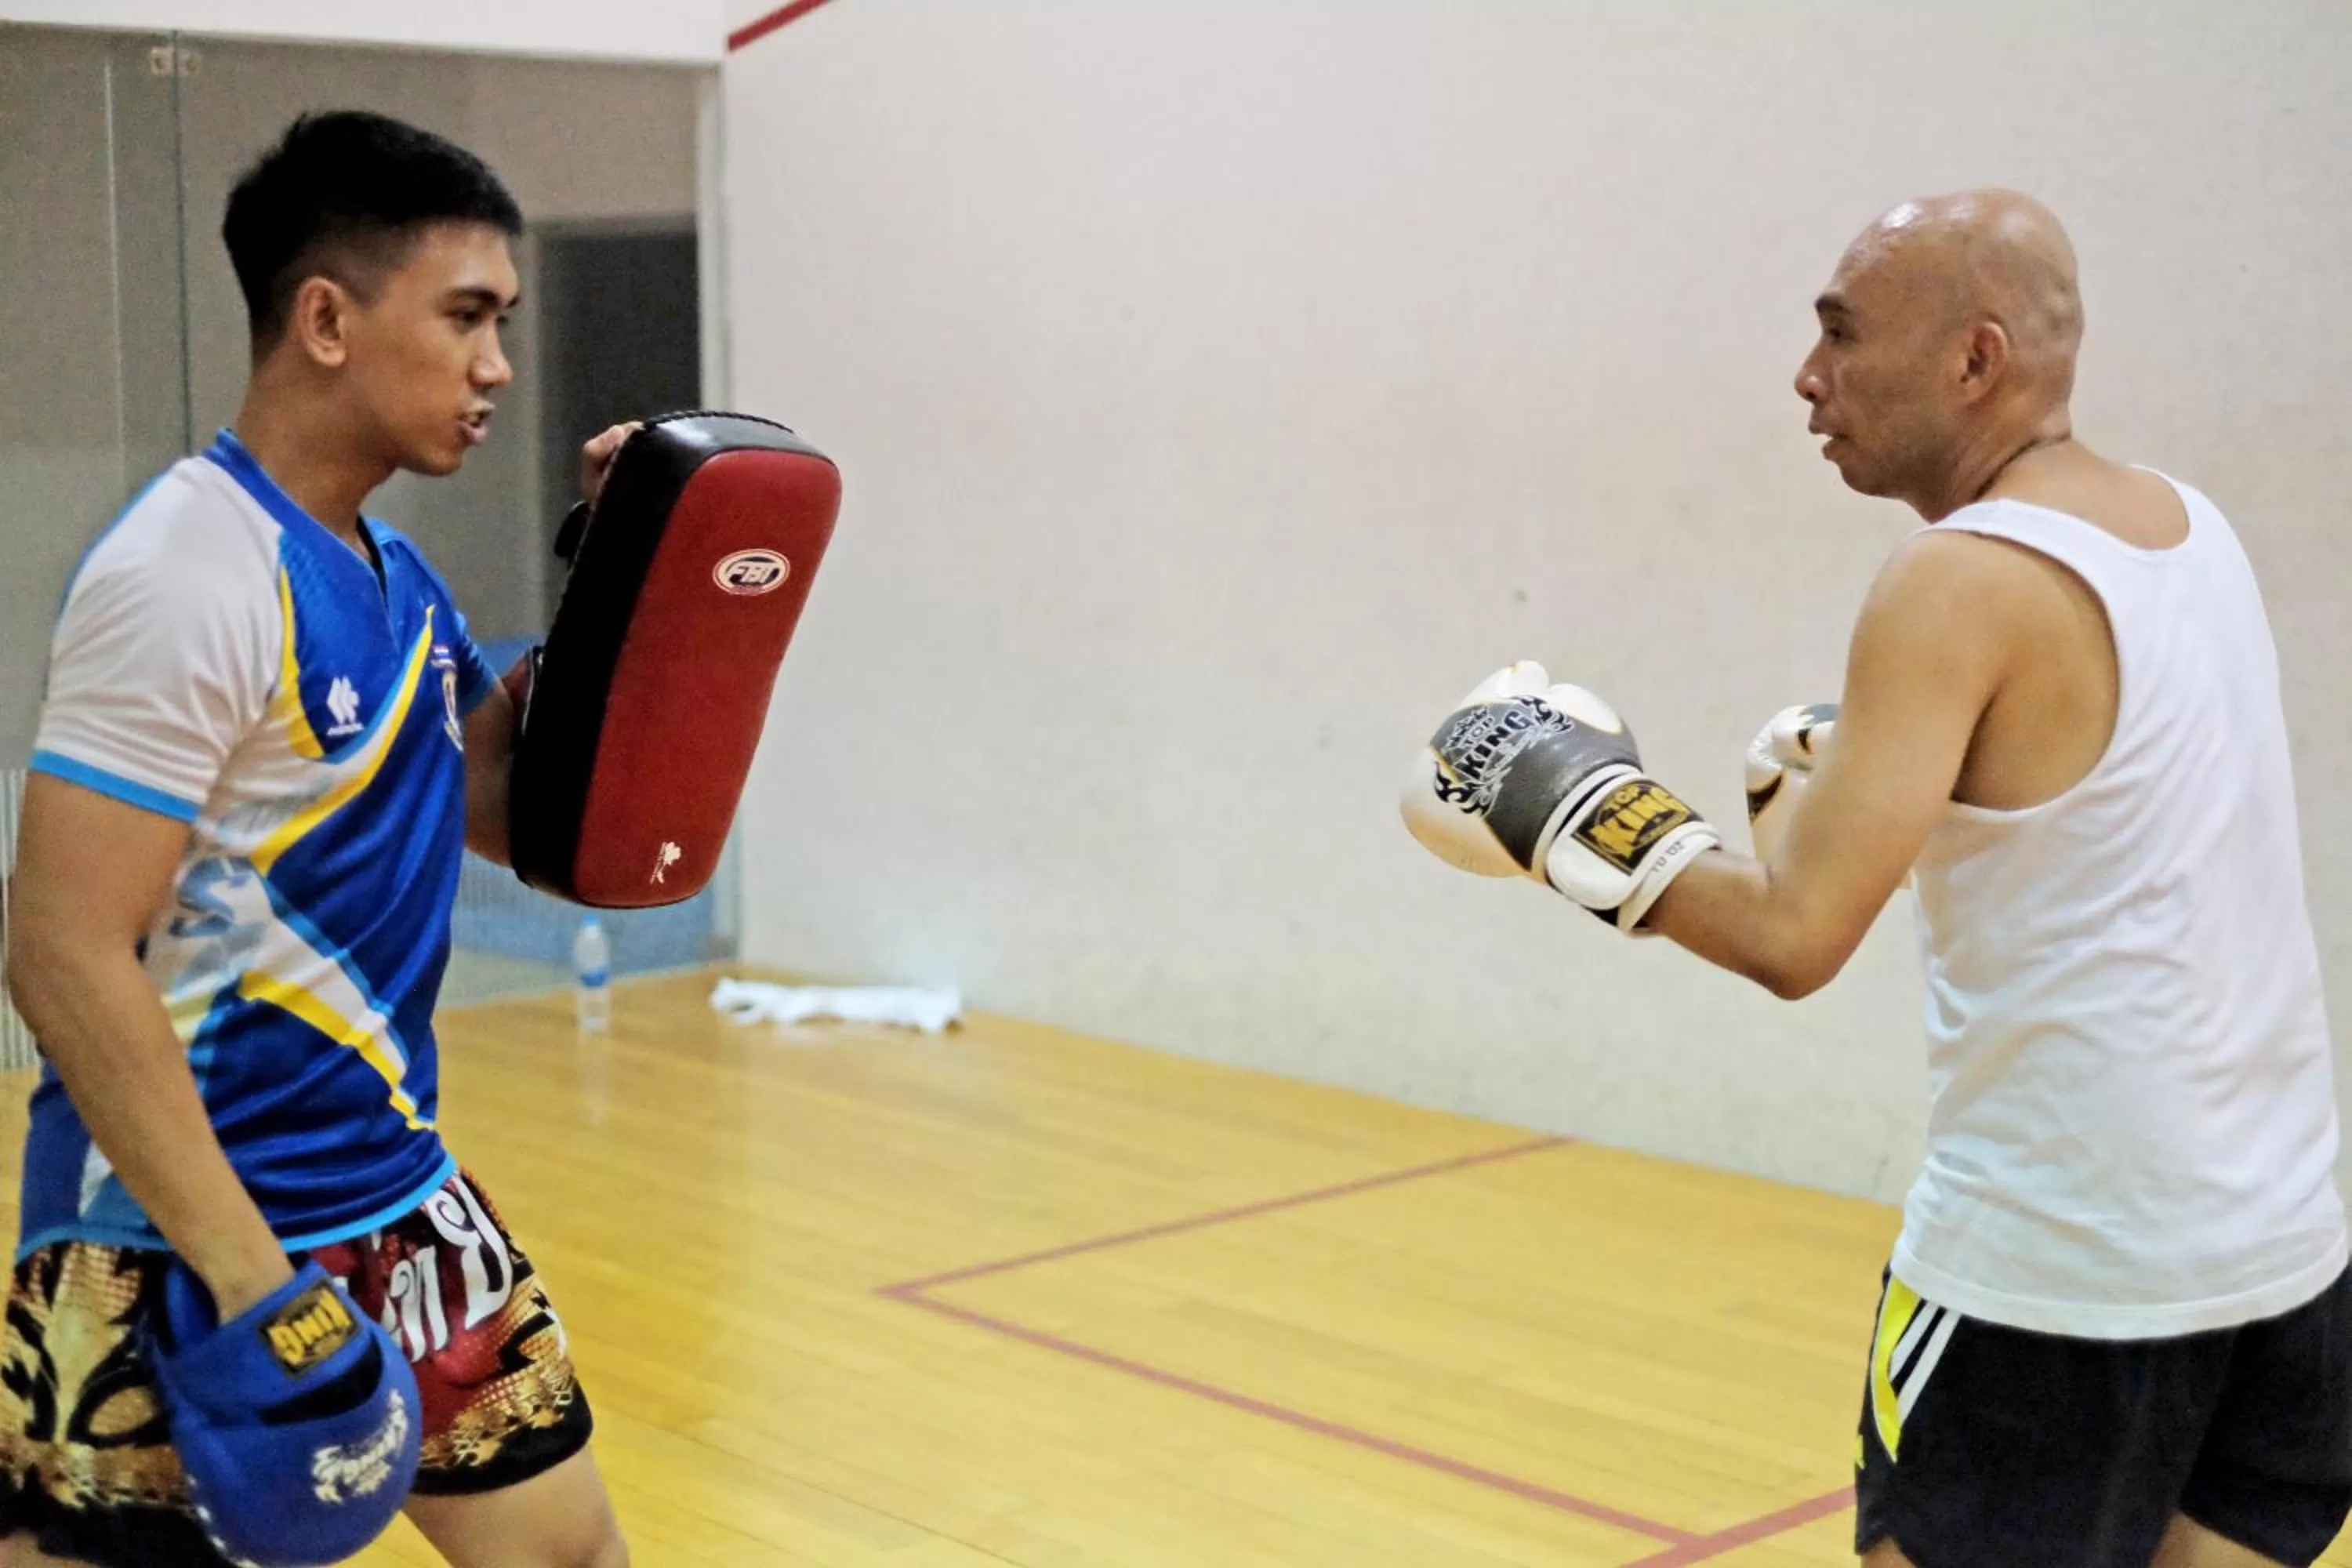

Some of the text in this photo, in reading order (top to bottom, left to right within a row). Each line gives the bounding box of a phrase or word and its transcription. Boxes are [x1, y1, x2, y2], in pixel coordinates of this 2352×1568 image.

[1461, 710, 1532, 780] KING
[1464, 716, 1495, 747] TOP
[1590, 787, 1690, 858] KING
